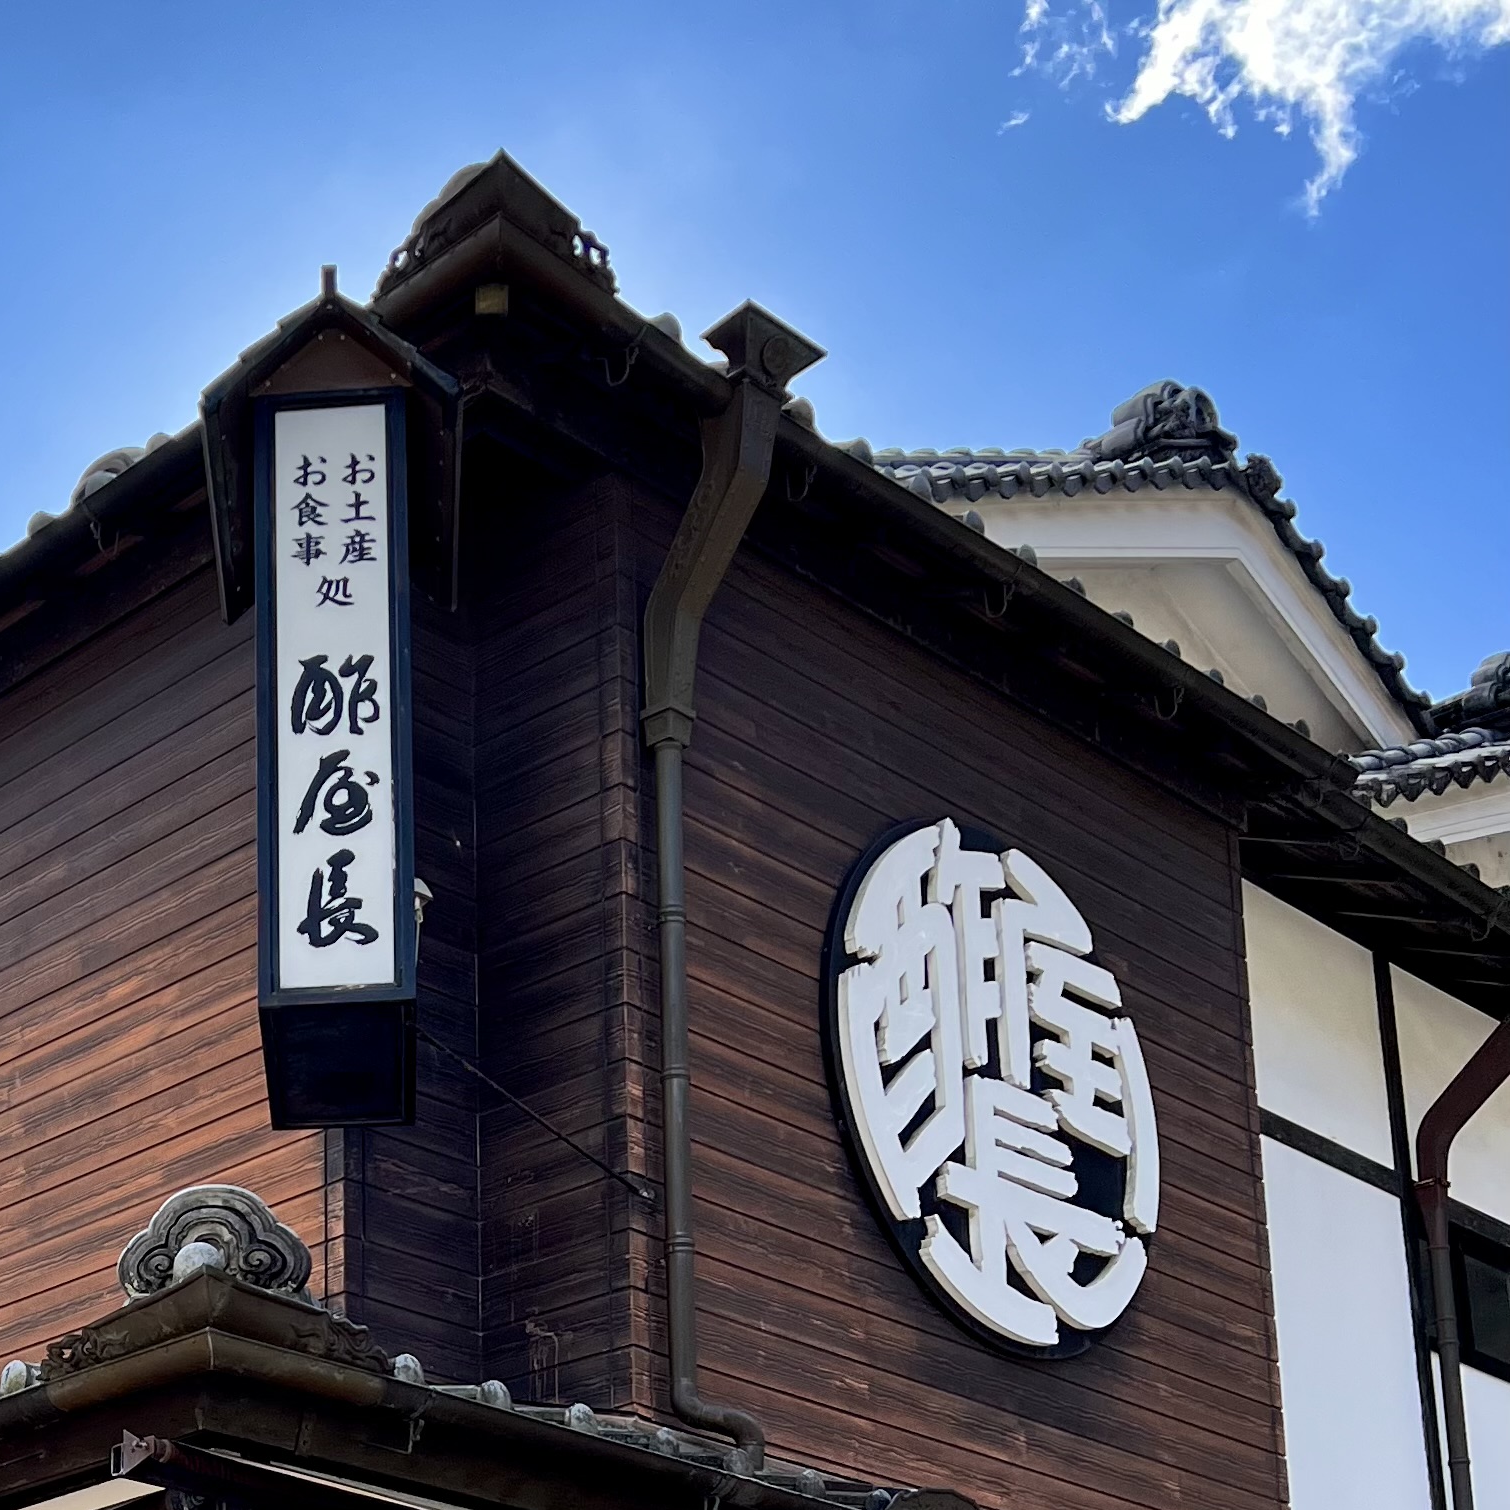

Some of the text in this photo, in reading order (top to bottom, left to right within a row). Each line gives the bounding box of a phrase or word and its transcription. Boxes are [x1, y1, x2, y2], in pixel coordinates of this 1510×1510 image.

[290, 454, 329, 563] お食事
[339, 453, 378, 565] お土産
[316, 575, 353, 608] 処
